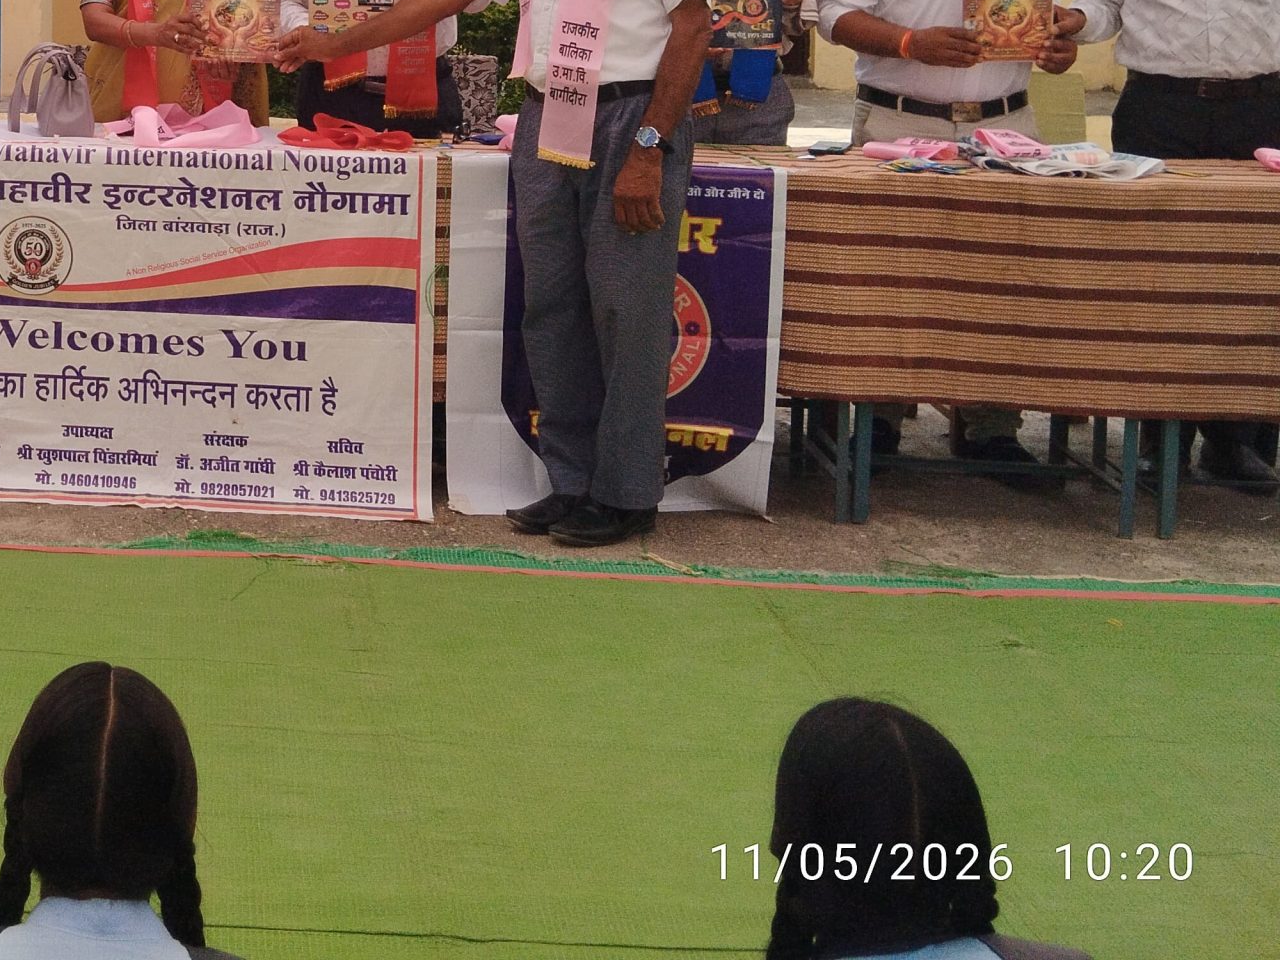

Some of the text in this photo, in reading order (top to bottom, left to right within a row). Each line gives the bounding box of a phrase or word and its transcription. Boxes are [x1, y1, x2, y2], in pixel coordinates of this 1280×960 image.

[562, 20, 600, 41] राजकीय
[558, 42, 594, 63] बालिका
[549, 86, 588, 107] बागीदौरा
[104, 144, 273, 172] International
[282, 149, 408, 181] Nougama
[102, 176, 283, 211] इन्टरनेशनल
[293, 181, 411, 216] नौगामा
[727, 187, 751, 200] जीने
[753, 188, 766, 200] दो
[116, 215, 287, 239] जिला बांसवाड़ा (राज.)
[24, 241, 44, 257] 50
[126, 268, 132, 276] A
[132, 266, 147, 276] Non
[148, 259, 179, 274] Religious
[180, 254, 201, 267] Social
[202, 247, 228, 262] Service
[219, 328, 308, 362] You
[33, 364, 110, 402] हार्दिक
[117, 369, 238, 409] अभिनन्दन
[245, 383, 312, 413] करता
[319, 376, 339, 417] है
[61, 425, 114, 440] उपाध्यक्ष
[202, 431, 249, 448] संरक्षक
[17, 444, 34, 460] श्री
[36, 448, 91, 465] खुशपाल
[326, 438, 365, 455] सचिव
[175, 453, 276, 475] डॉ. अजीत गांधी
[292, 462, 310, 478] श्री
[312, 460, 356, 480] कैलाश
[35, 469, 137, 490] मो. 9460410946
[174, 479, 276, 499] मो. 9828057021
[292, 486, 396, 505] मो. 9413625729
